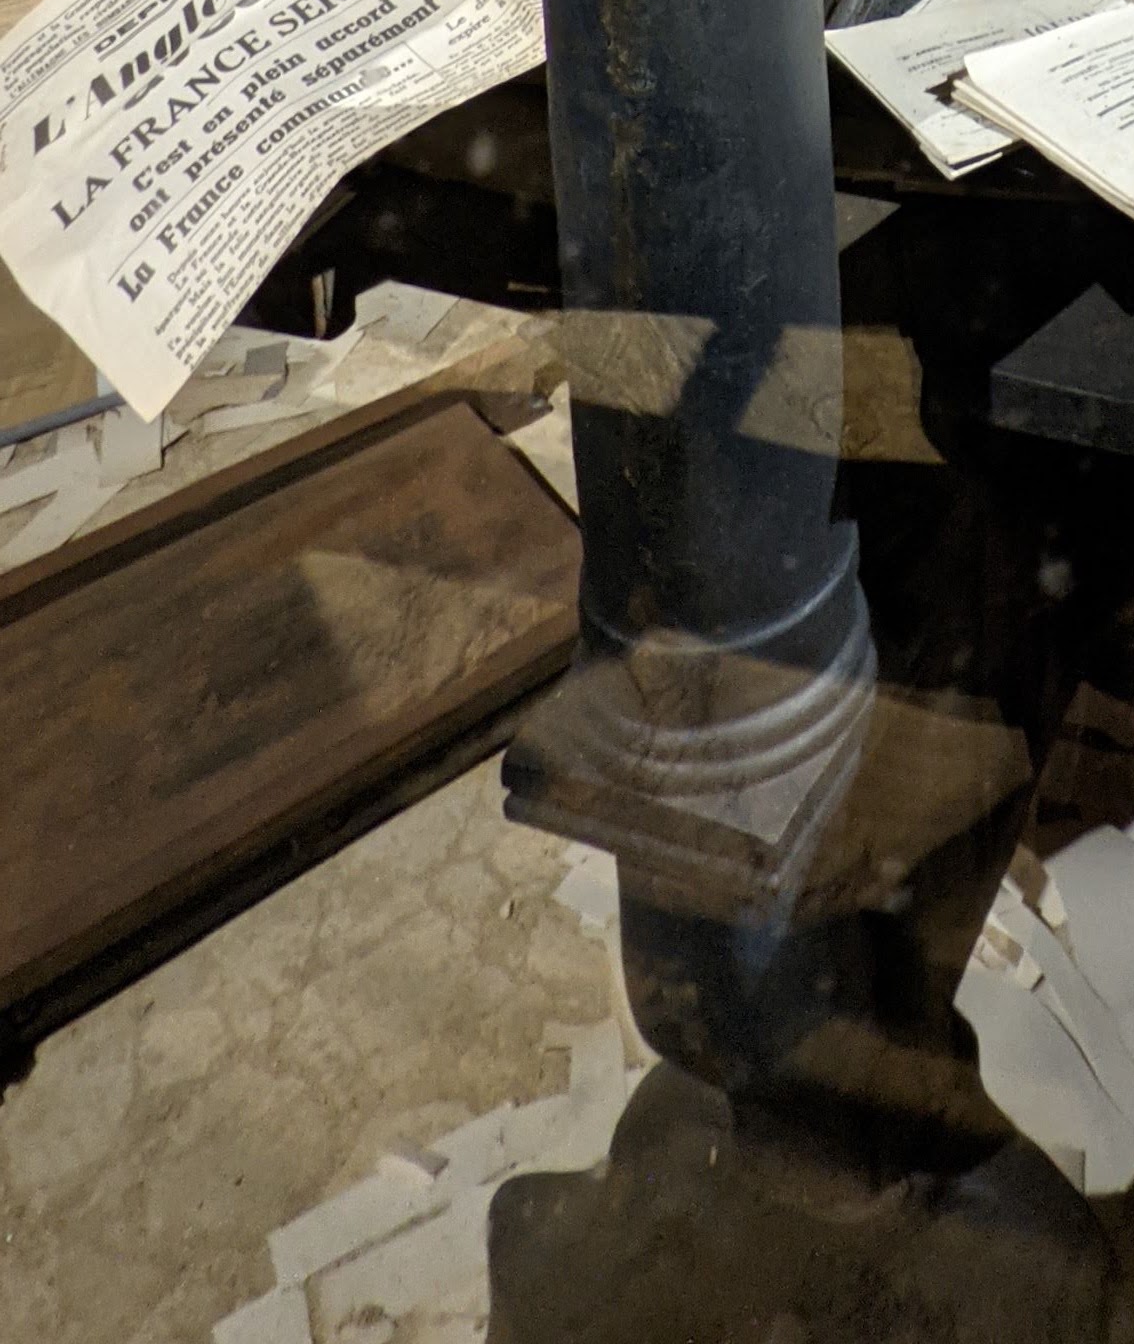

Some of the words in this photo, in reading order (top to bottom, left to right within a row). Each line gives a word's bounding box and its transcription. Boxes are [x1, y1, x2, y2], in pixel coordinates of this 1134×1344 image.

[51, 175, 112, 231] LA
[109, 29, 271, 171] FRANCE
[129, 187, 171, 234] ont
[183, 87, 287, 184] présenté
[202, 106, 234, 135] en
[240, 52, 307, 102] plein
[116, 261, 156, 304] La
[155, 164, 245, 254] France
